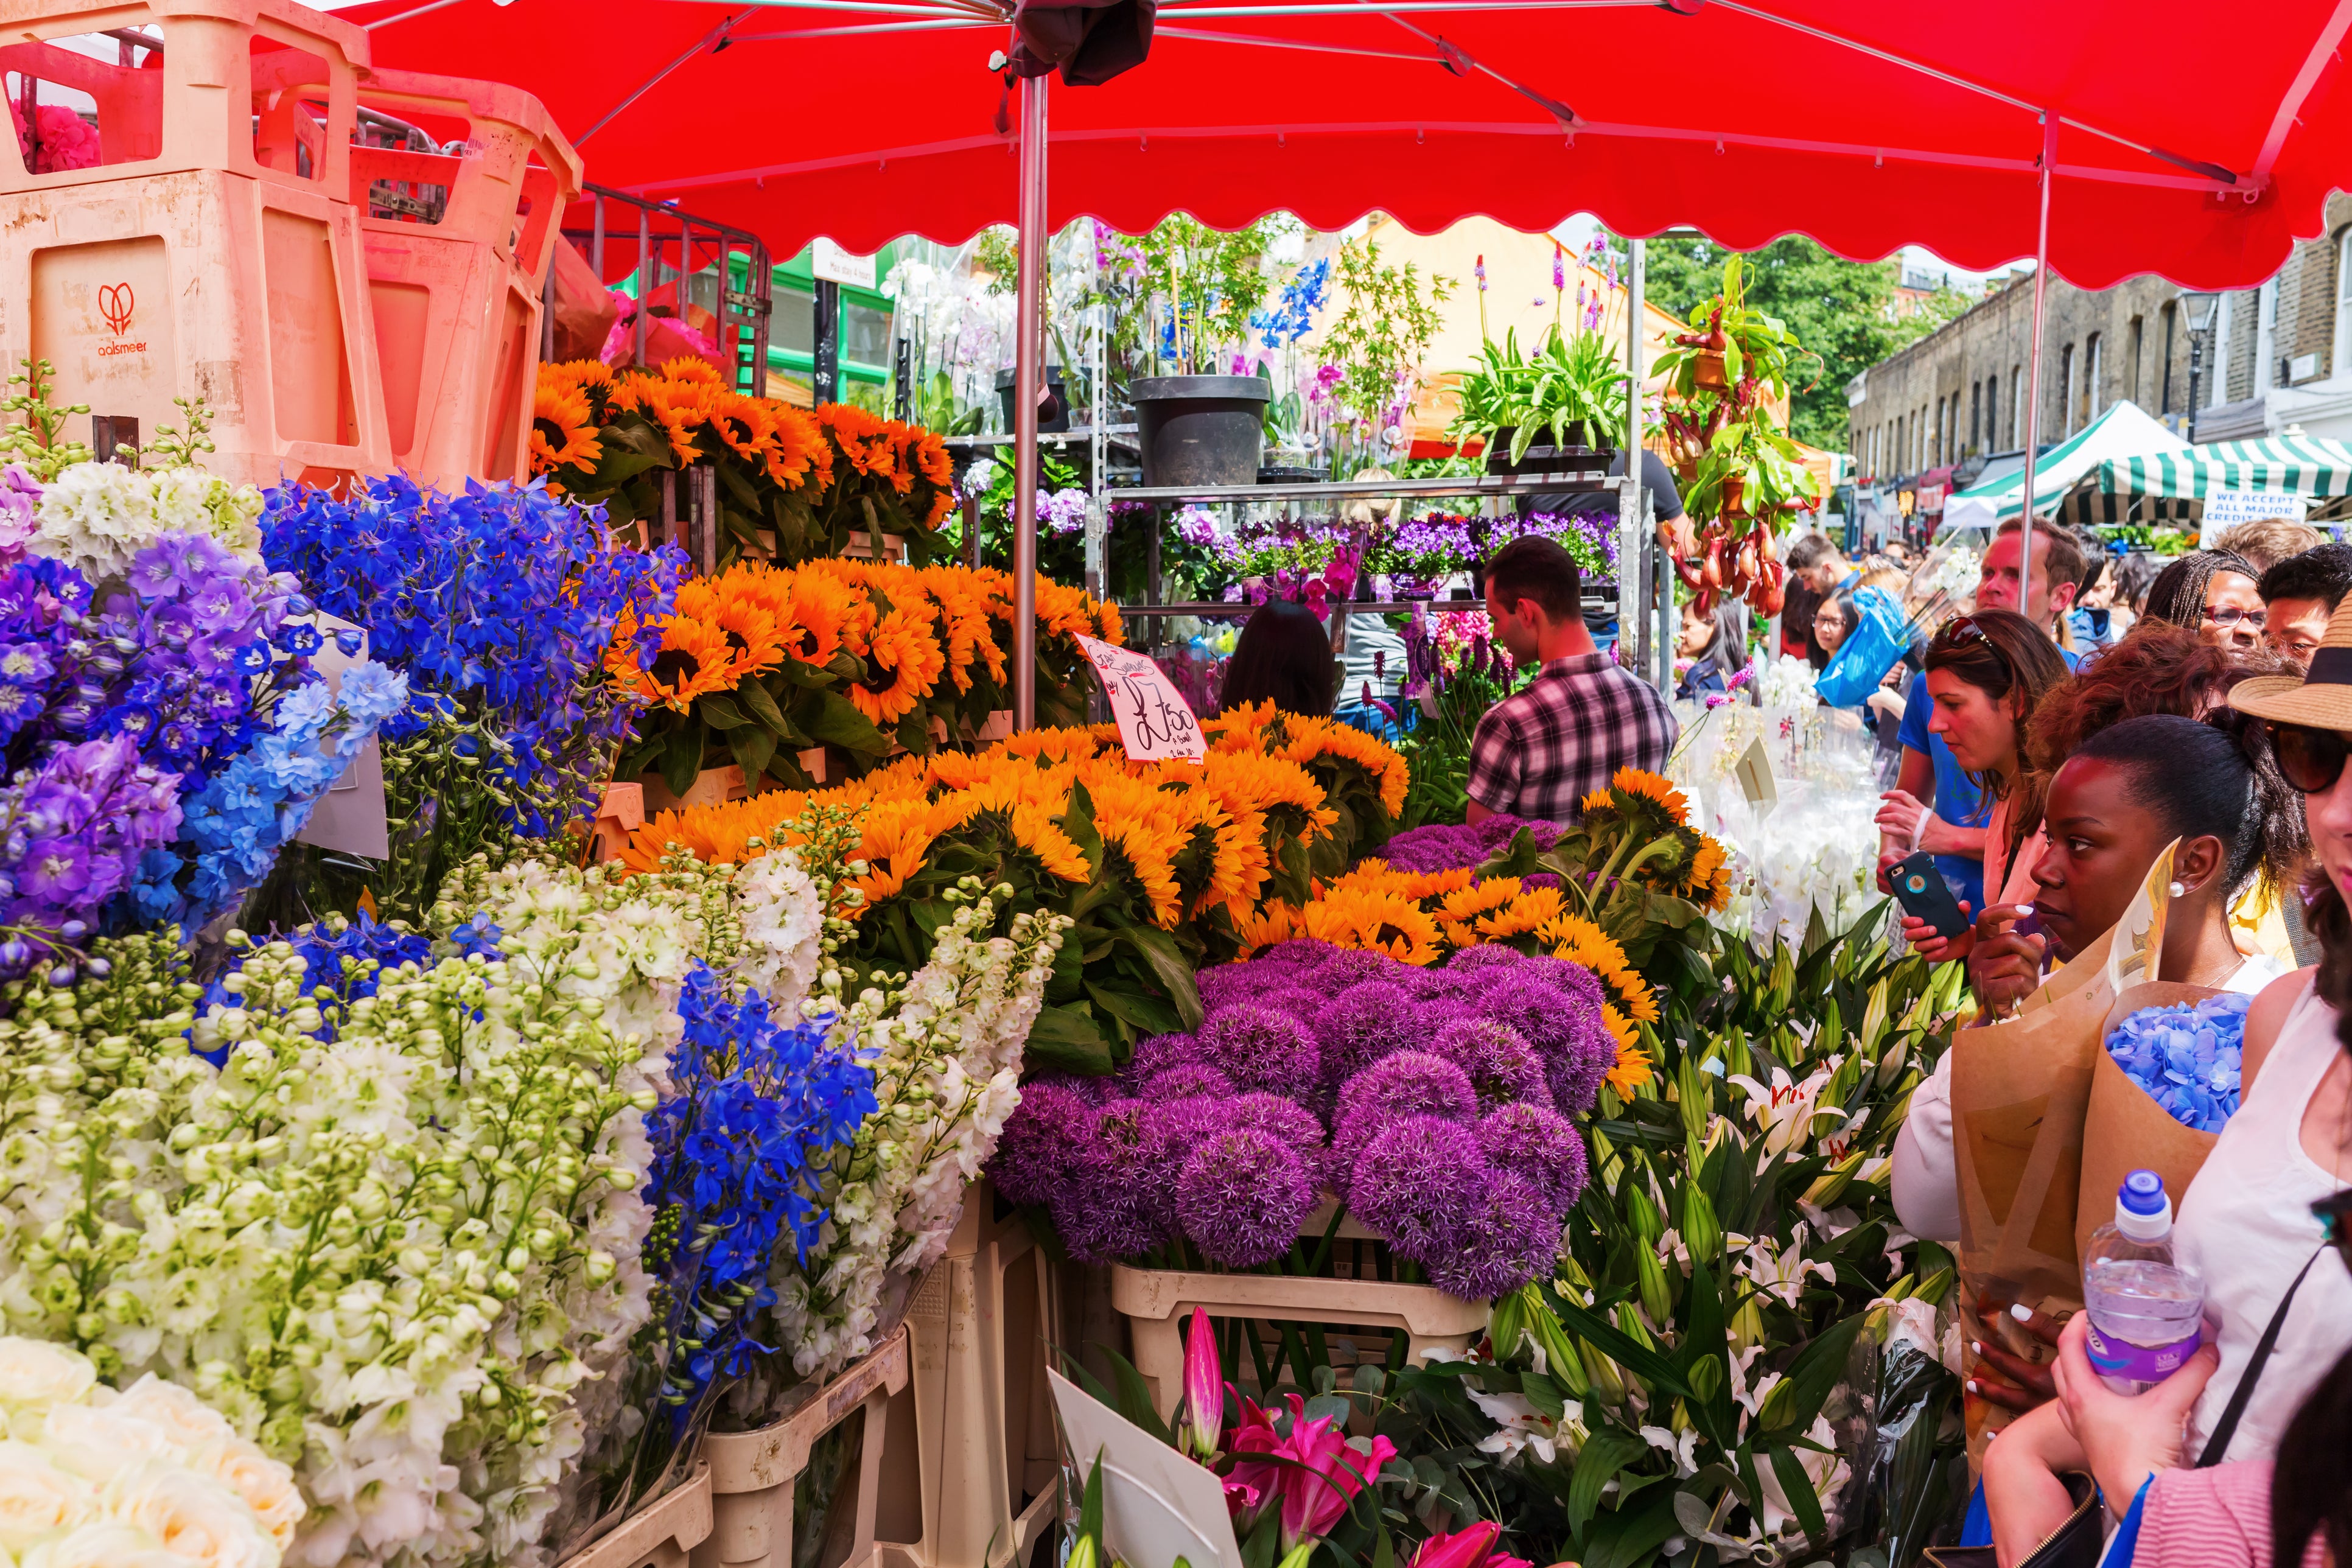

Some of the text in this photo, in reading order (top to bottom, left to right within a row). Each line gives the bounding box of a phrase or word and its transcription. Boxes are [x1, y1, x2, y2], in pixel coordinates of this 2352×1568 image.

[98, 341, 147, 356] aalsmeer
[2242, 495, 2295, 505] ACCEPT
[2245, 506, 2294, 515] MAJOR
[2207, 513, 2254, 522] CREDIT
